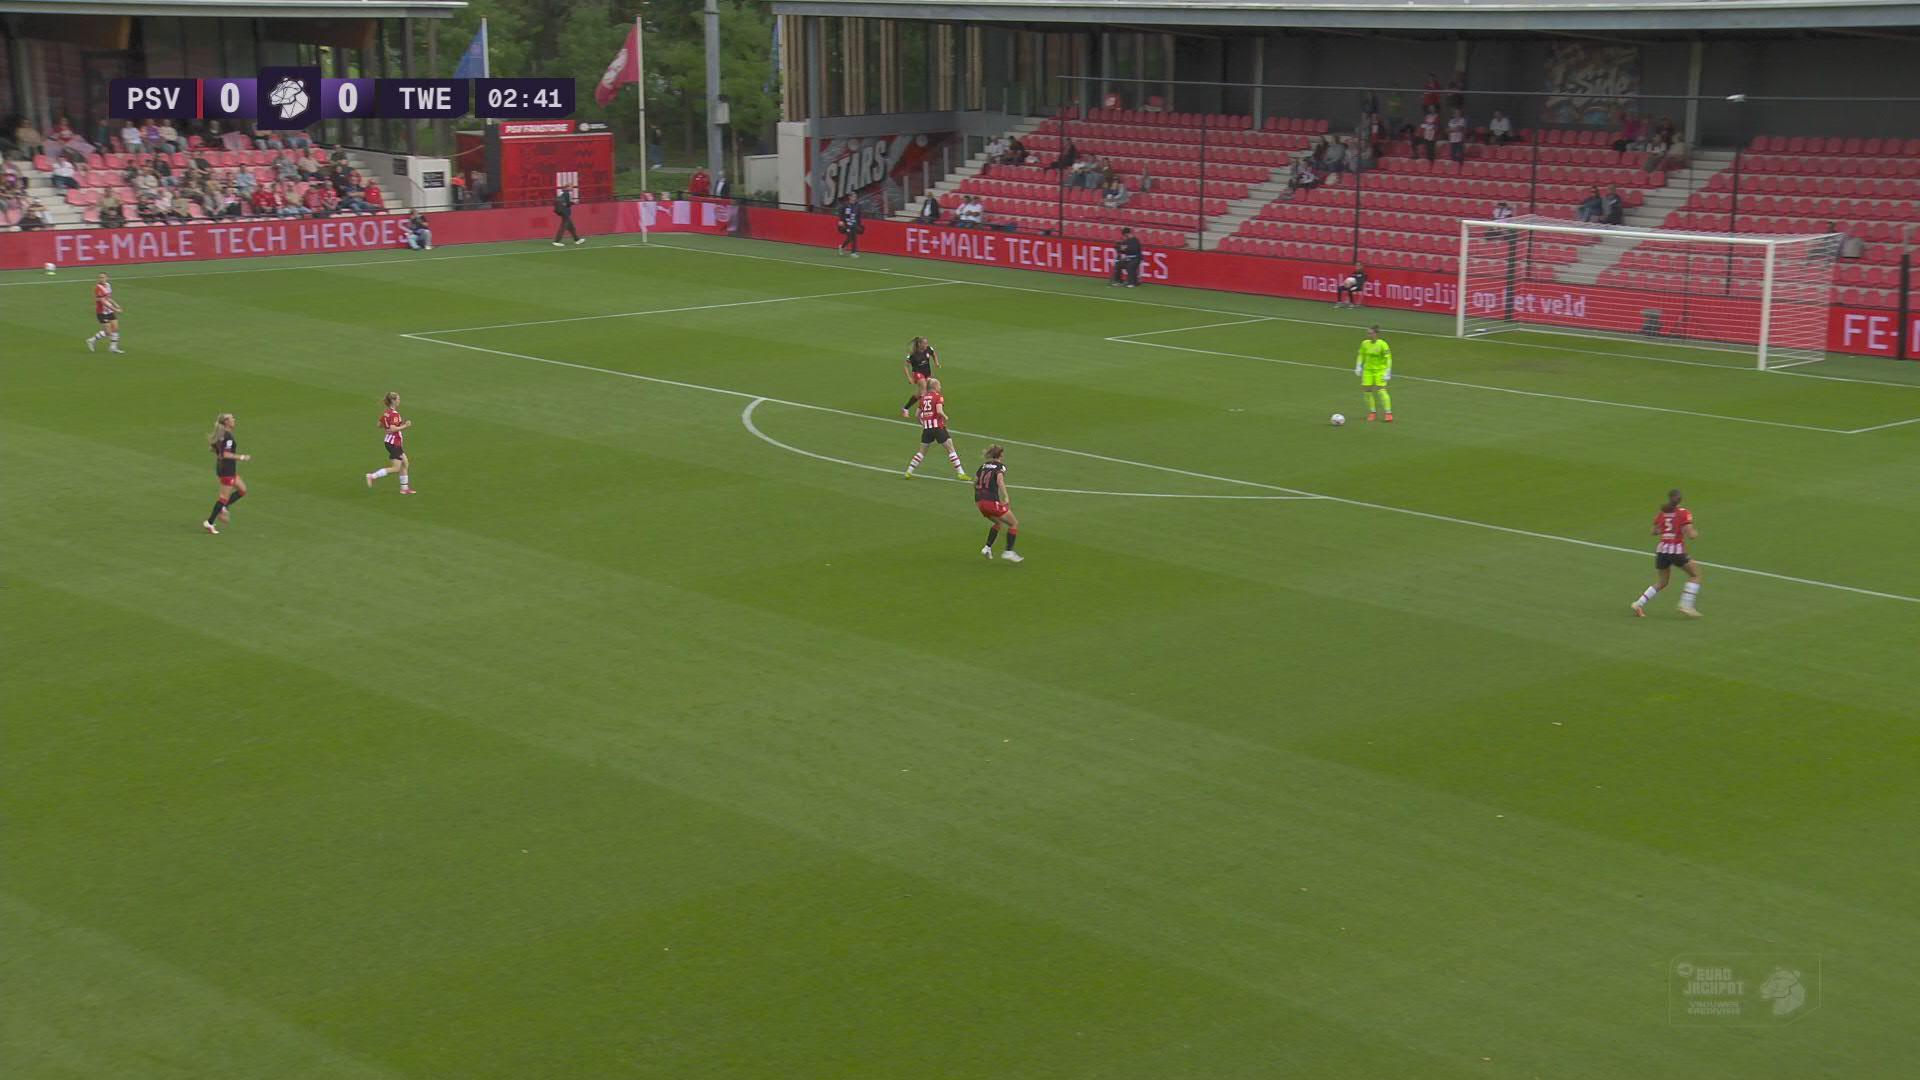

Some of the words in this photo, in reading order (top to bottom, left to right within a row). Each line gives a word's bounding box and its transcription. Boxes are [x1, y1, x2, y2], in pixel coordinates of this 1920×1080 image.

[824, 139, 887, 206] STARS
[55, 229, 196, 262] FE+MALE
[208, 224, 288, 255] TECH
[905, 227, 997, 261] FE+MALE
[1004, 236, 1063, 269] TECH
[1071, 244, 1169, 280] HERES
[1386, 282, 1457, 310] mogelij
[1472, 291, 1497, 313] op
[1540, 293, 1586, 318] veld
[923, 399, 932, 411] 25
